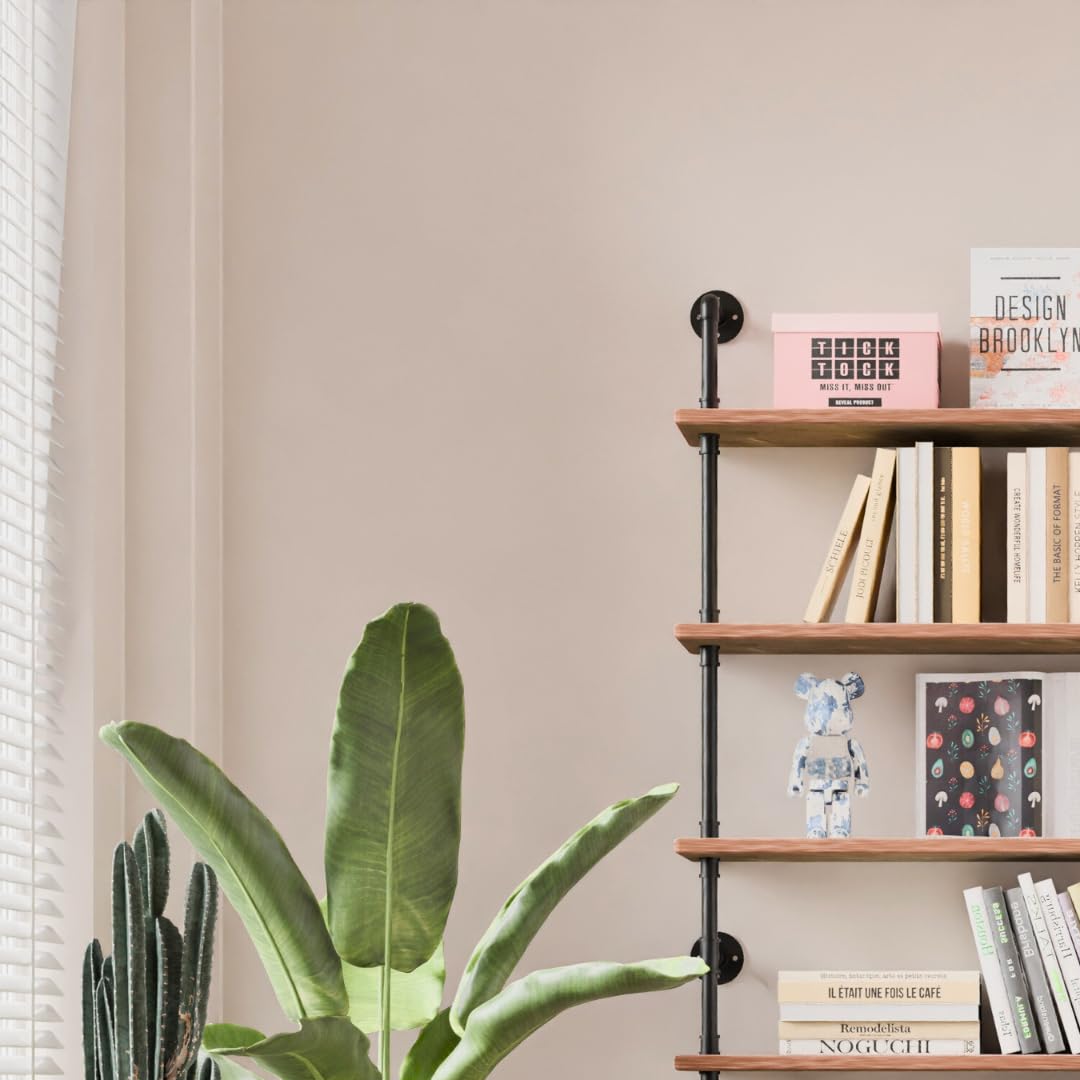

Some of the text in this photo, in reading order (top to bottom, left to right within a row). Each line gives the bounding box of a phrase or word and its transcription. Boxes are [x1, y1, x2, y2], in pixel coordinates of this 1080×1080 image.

[995, 296, 1066, 320] DESIGN
[815, 340, 896, 356] TICK
[815, 361, 896, 377] TOCK
[842, 384, 851, 392] IT,
[1053, 484, 1062, 583] THE BASIC OF FORMAT
[826, 529, 848, 573] SCHIELE
[828, 985, 941, 998] IL ÉTAIT UNE FOIS LE CAFÉ
[840, 1023, 911, 1033] Remodelista
[820, 1040, 929, 1053] NOGUCHI
